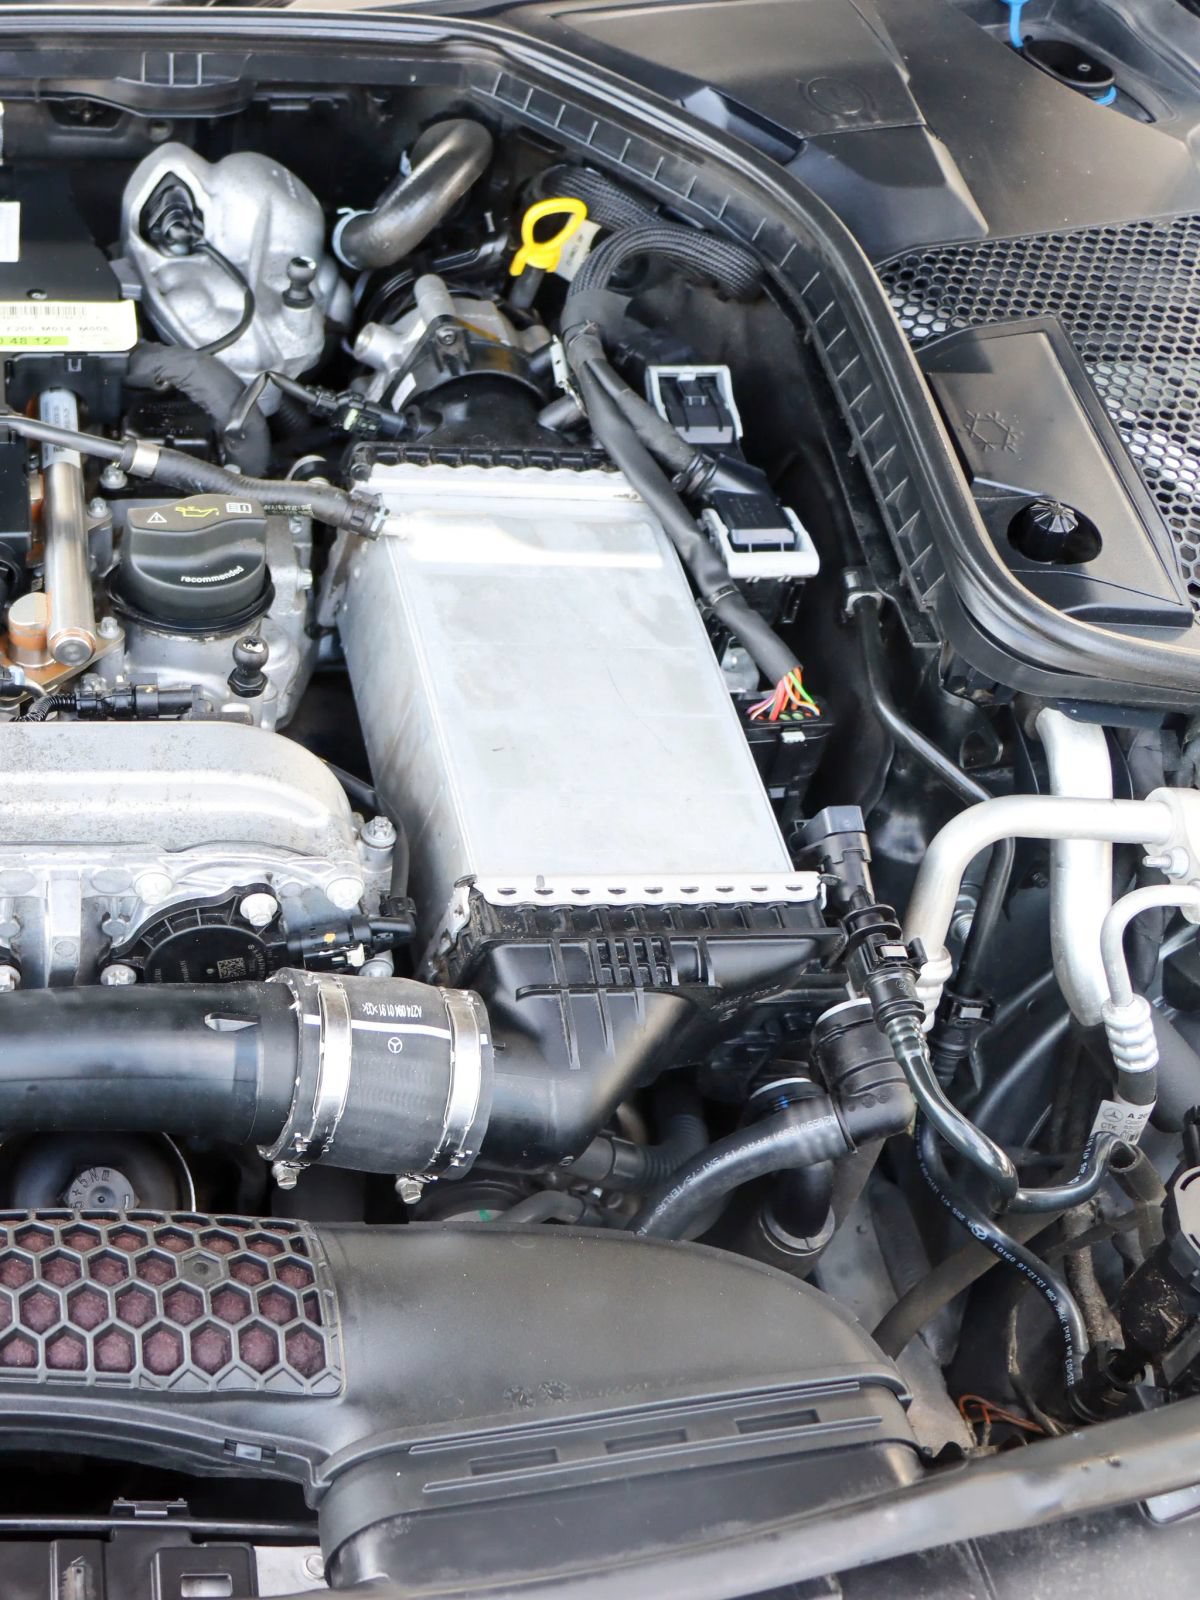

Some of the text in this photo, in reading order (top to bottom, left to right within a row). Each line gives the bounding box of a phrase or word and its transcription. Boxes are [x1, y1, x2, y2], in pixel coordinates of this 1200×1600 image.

[9, 336, 28, 346] 48
[33, 336, 52, 345] 12
[180, 565, 245, 583] recommended
